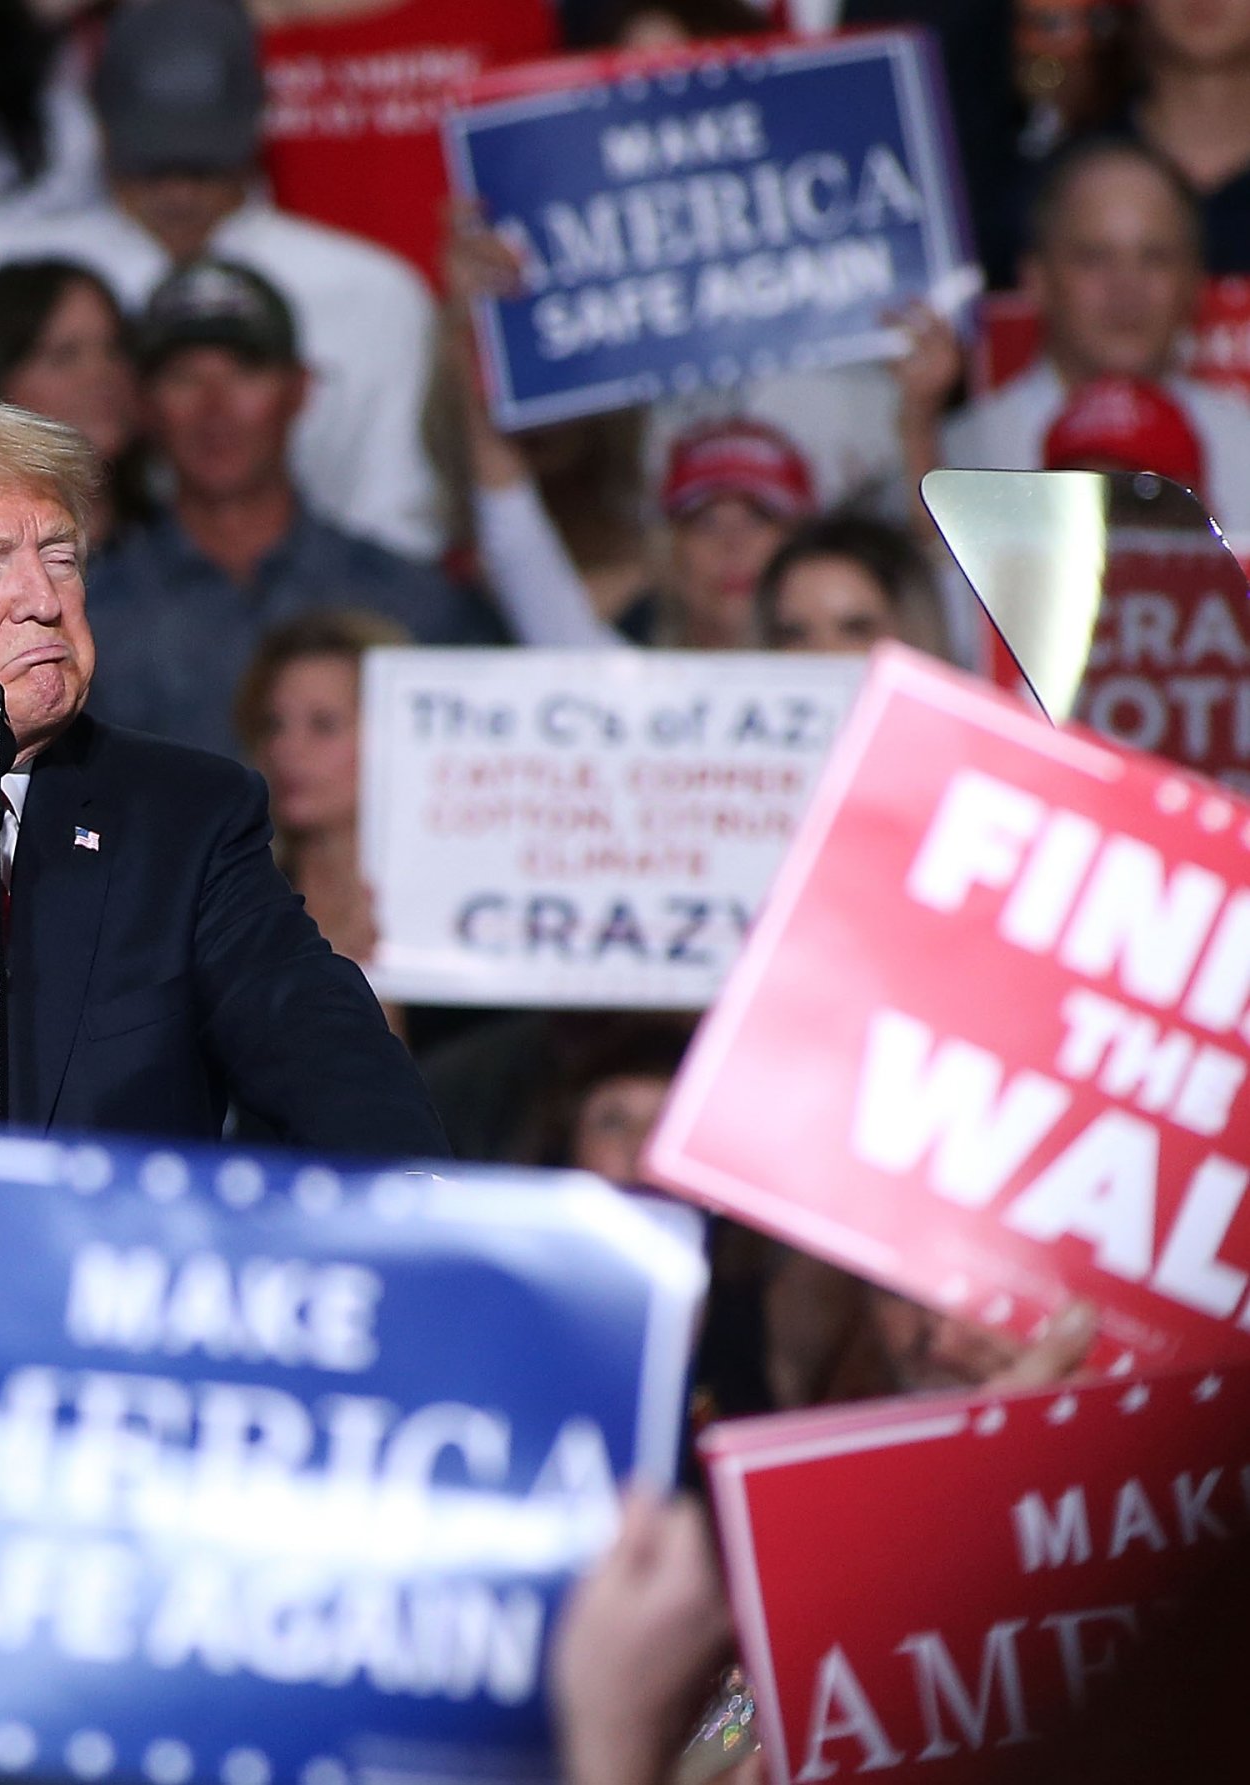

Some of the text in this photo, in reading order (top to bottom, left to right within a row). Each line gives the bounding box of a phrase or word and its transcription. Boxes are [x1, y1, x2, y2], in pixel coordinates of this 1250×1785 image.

[531, 235, 893, 360] SAFE AGAIN
[905, 766, 1250, 1040] FINI
[1057, 987, 1247, 1138] THE
[852, 1005, 1250, 1334] WAL
[62, 1239, 384, 1373] MAKE
[154, 1550, 548, 1708] AGAIN
